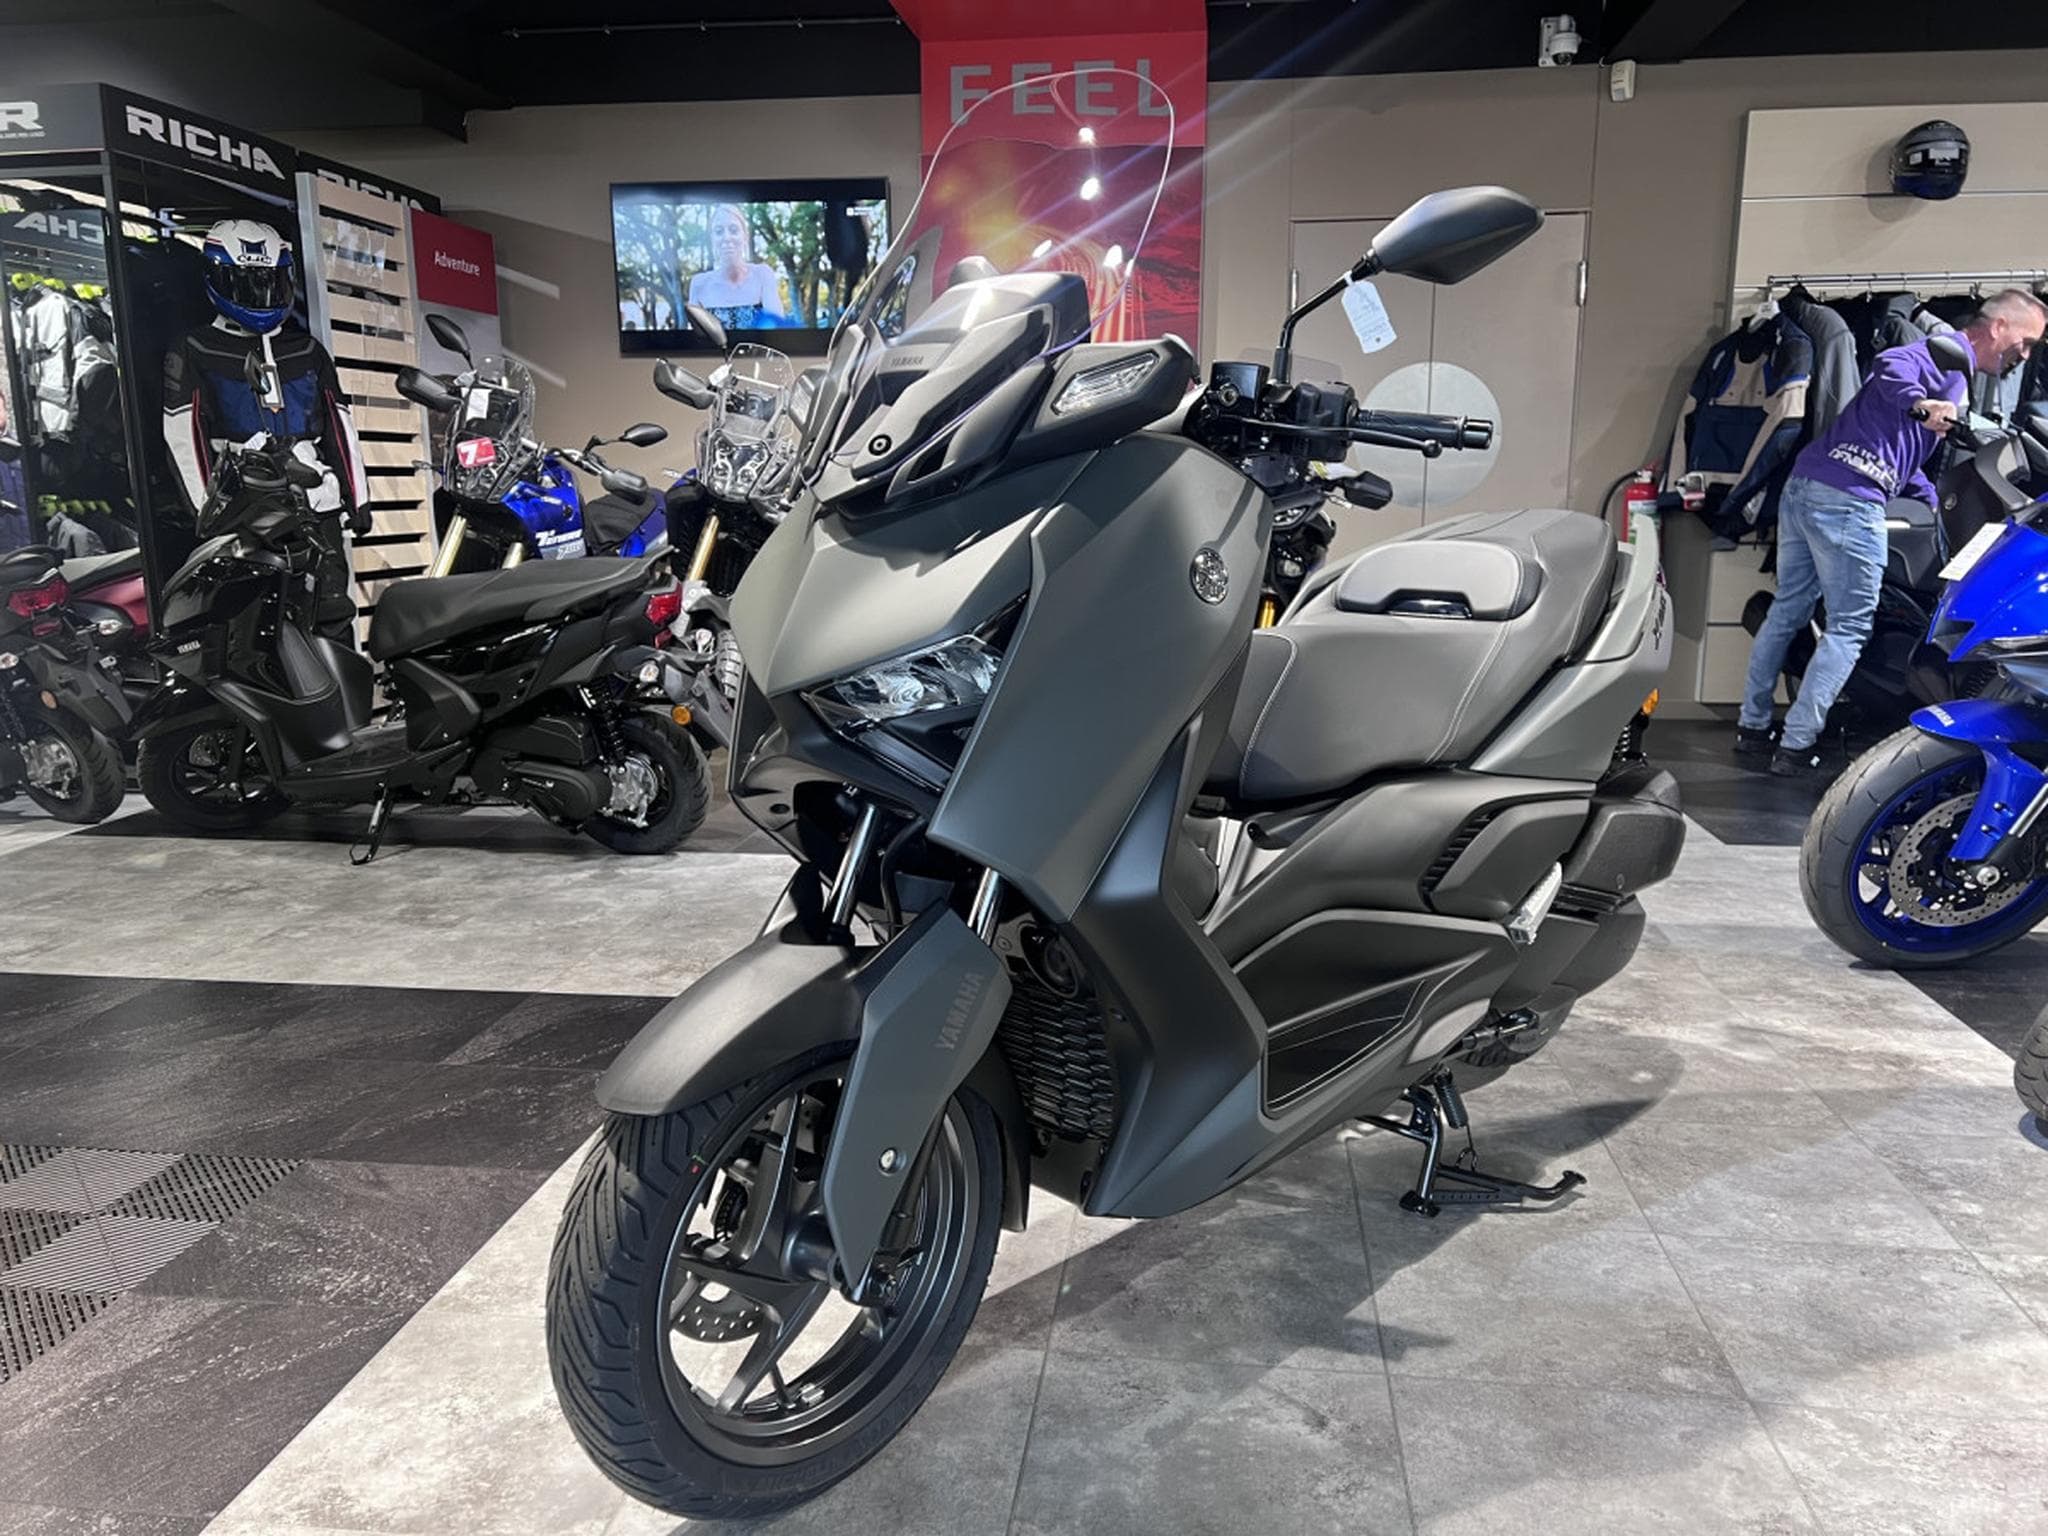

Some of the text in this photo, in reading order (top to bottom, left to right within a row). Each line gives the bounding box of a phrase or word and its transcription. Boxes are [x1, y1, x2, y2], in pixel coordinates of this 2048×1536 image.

[951, 59, 1171, 126] FEEL
[125, 105, 285, 180] RICHA
[434, 251, 481, 277] Adventure
[932, 971, 984, 1050] YAMAHA
